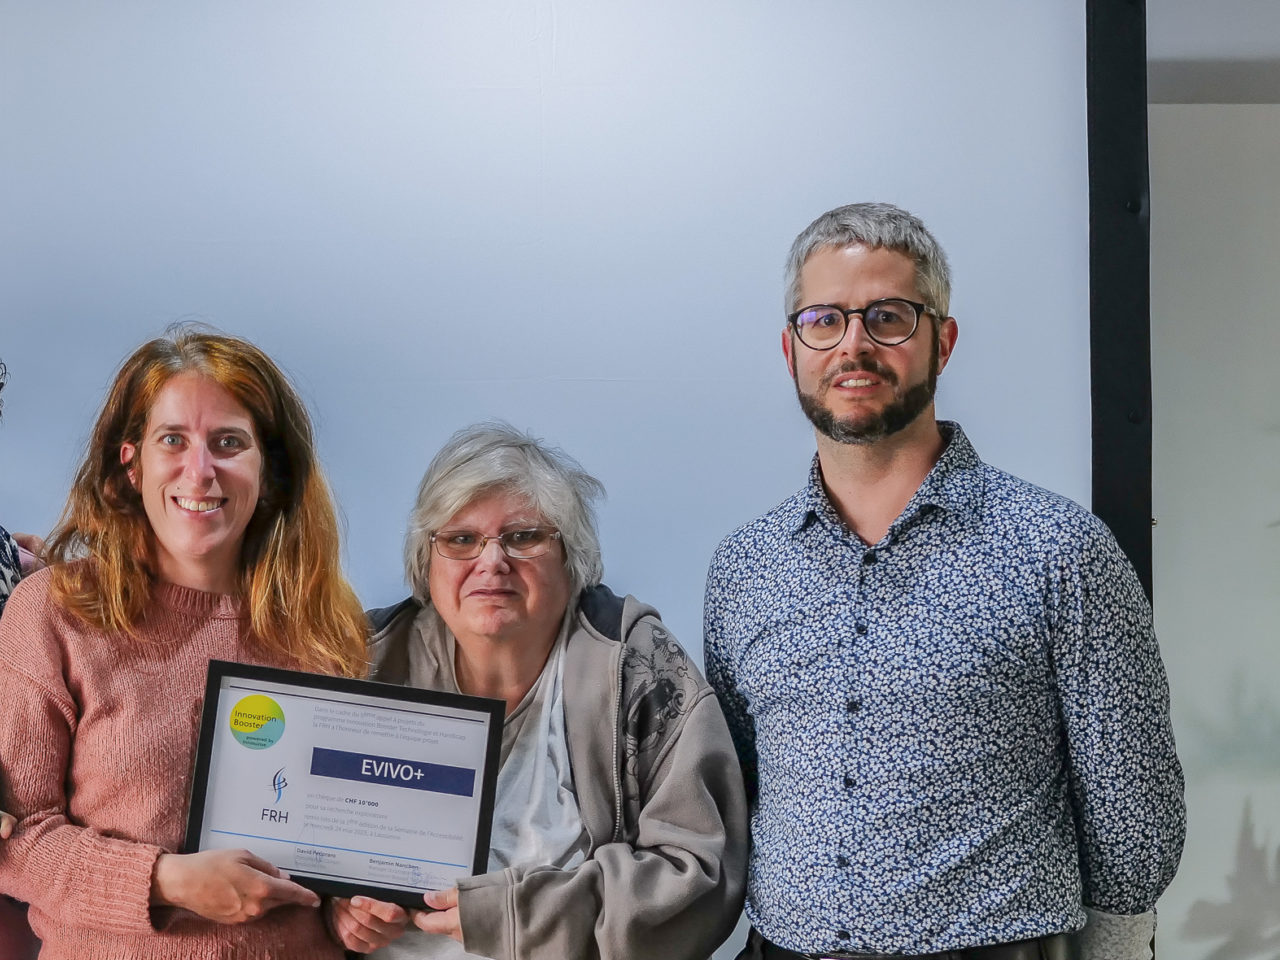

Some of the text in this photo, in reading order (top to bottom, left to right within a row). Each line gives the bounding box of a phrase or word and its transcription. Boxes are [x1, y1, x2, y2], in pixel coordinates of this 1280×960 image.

[234, 710, 277, 723] Innovation
[234, 718, 264, 729] Booster
[361, 759, 424, 781] EVIVO+
[358, 799, 380, 808] 10'000
[261, 808, 288, 823] FRH
[369, 858, 394, 866] Benjamin
